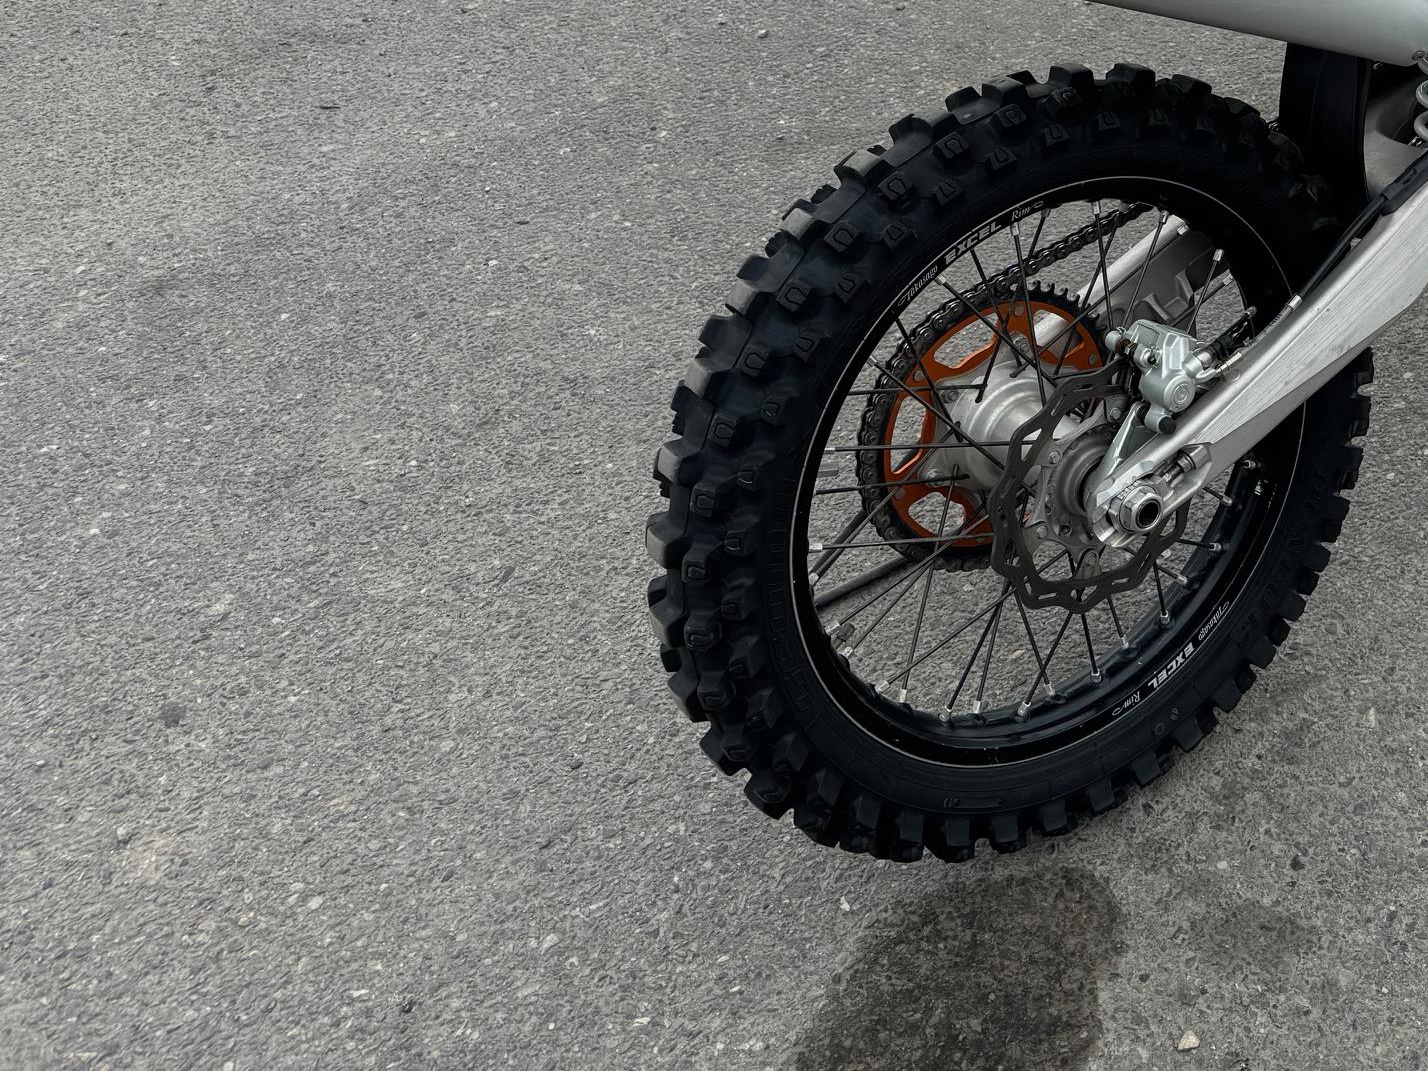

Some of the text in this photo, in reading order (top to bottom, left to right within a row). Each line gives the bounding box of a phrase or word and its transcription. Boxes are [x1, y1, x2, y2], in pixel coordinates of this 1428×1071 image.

[898, 201, 1044, 306] Takasago EXCEL Rim
[1112, 601, 1230, 716] Takasago EXCEL Rim
